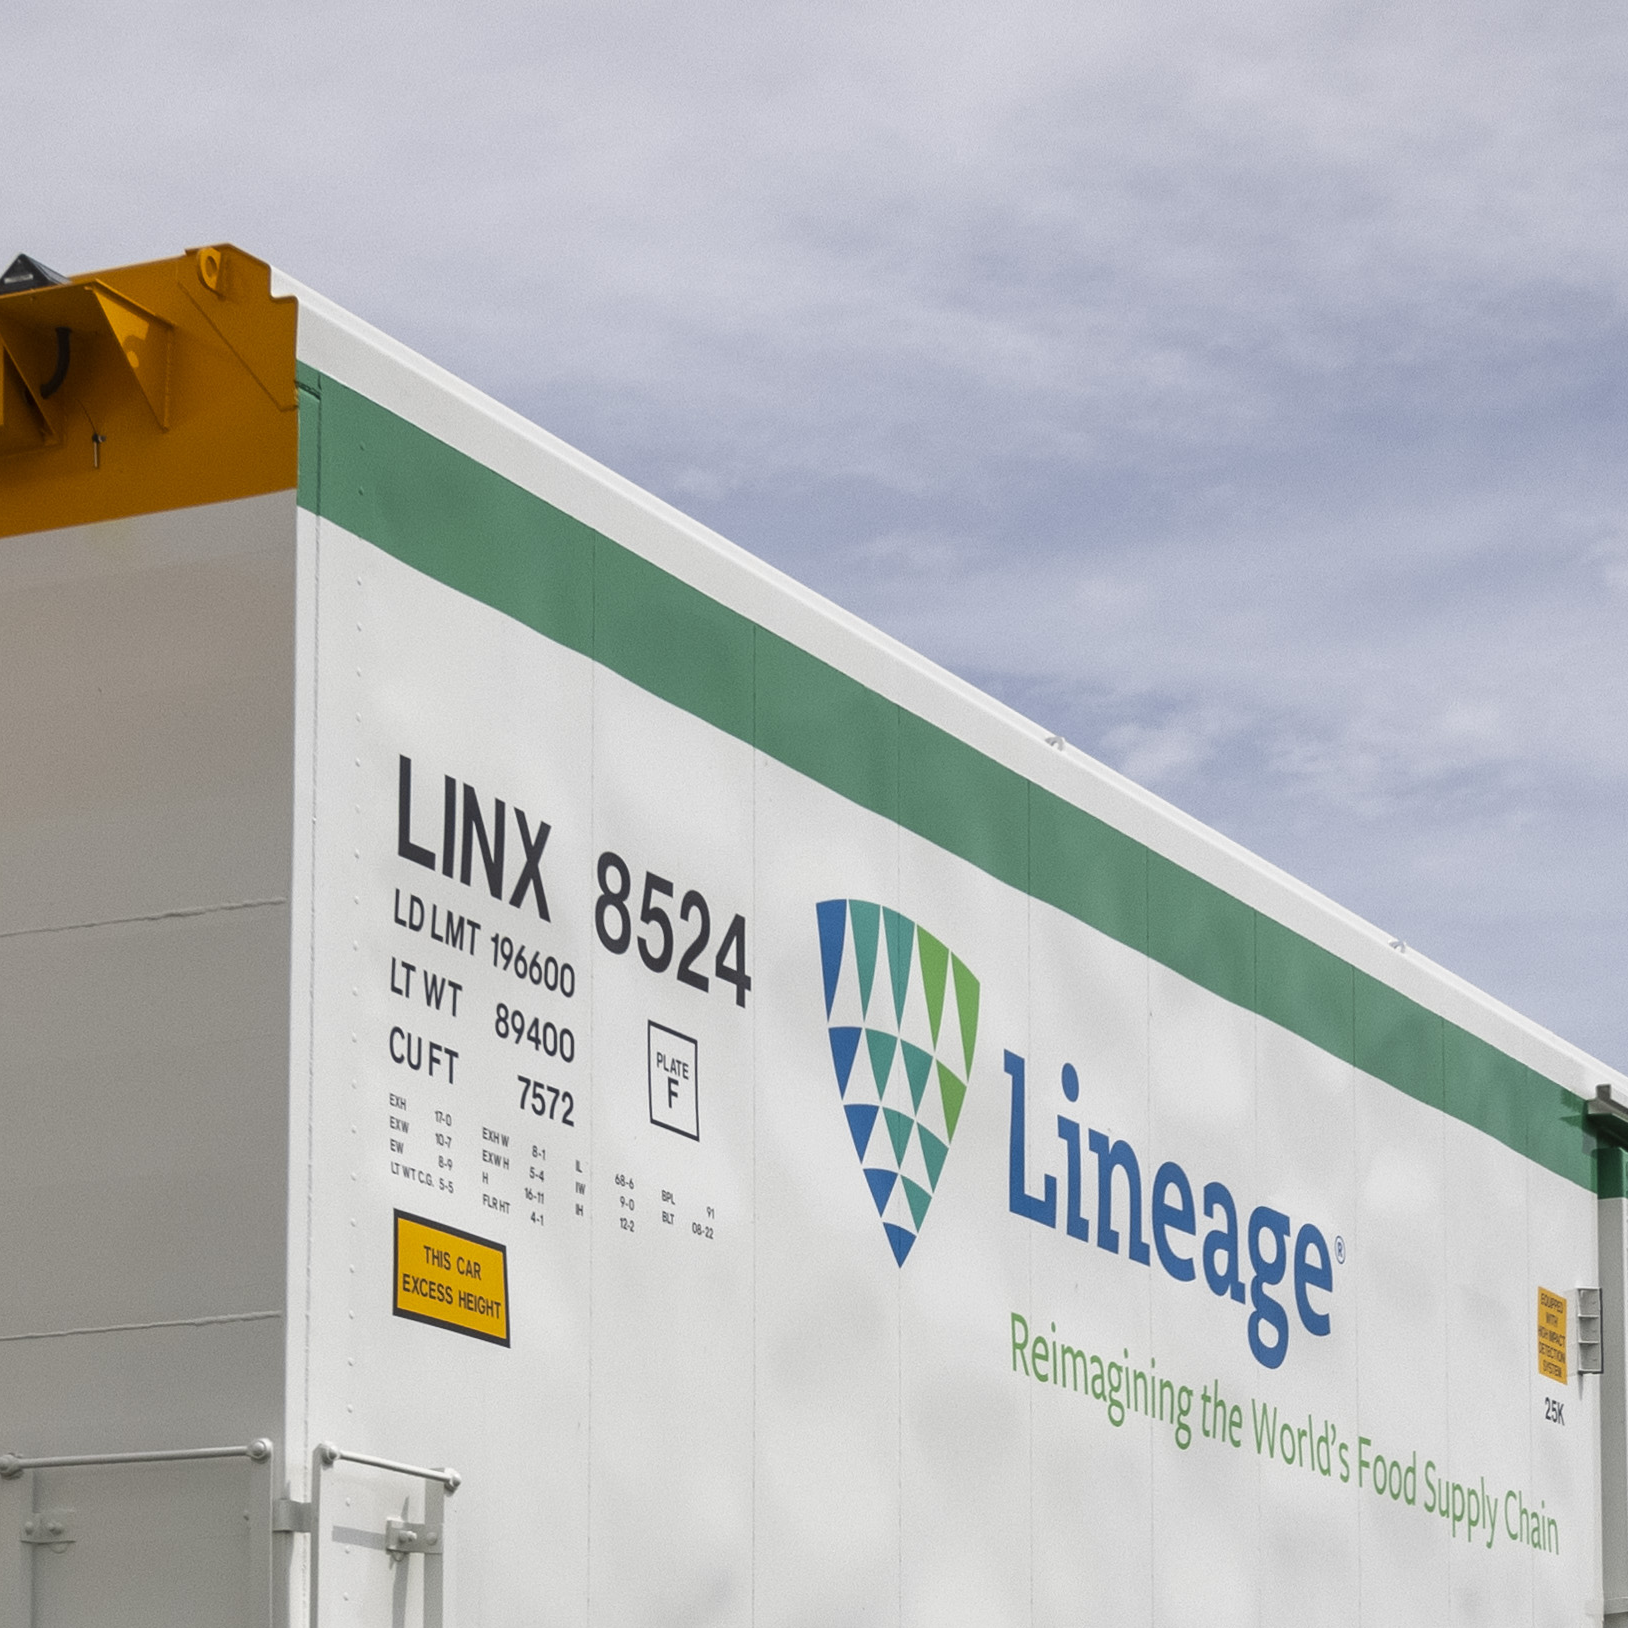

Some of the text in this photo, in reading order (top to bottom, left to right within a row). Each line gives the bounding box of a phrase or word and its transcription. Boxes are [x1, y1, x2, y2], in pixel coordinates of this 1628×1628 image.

[398, 753, 752, 1009] LINX 8524
[394, 888, 575, 998] LD LMT 196600
[390, 956, 575, 1063] LT WT 89400
[389, 1026, 575, 1128] CU FT 7572
[656, 1051, 689, 1081] PLATE
[389, 1093, 452, 1127] EXH 17-0
[667, 1077, 679, 1109] F
[389, 1115, 409, 1134] EXW
[390, 1138, 404, 1155] EW
[482, 1127, 500, 1144] EXH
[532, 1145, 546, 1161] 8-1
[439, 1178, 454, 1194] 5-5
[529, 1166, 545, 1182] 5-4
[530, 1211, 544, 1226] 4-1
[423, 1245, 482, 1281] THIS CAR
[402, 1273, 501, 1319] EXCESS HEIGHT
[1545, 1397, 1565, 1426] 25K
[1011, 1312, 1559, 1556] Reimagining the World's Food Supply Chain
